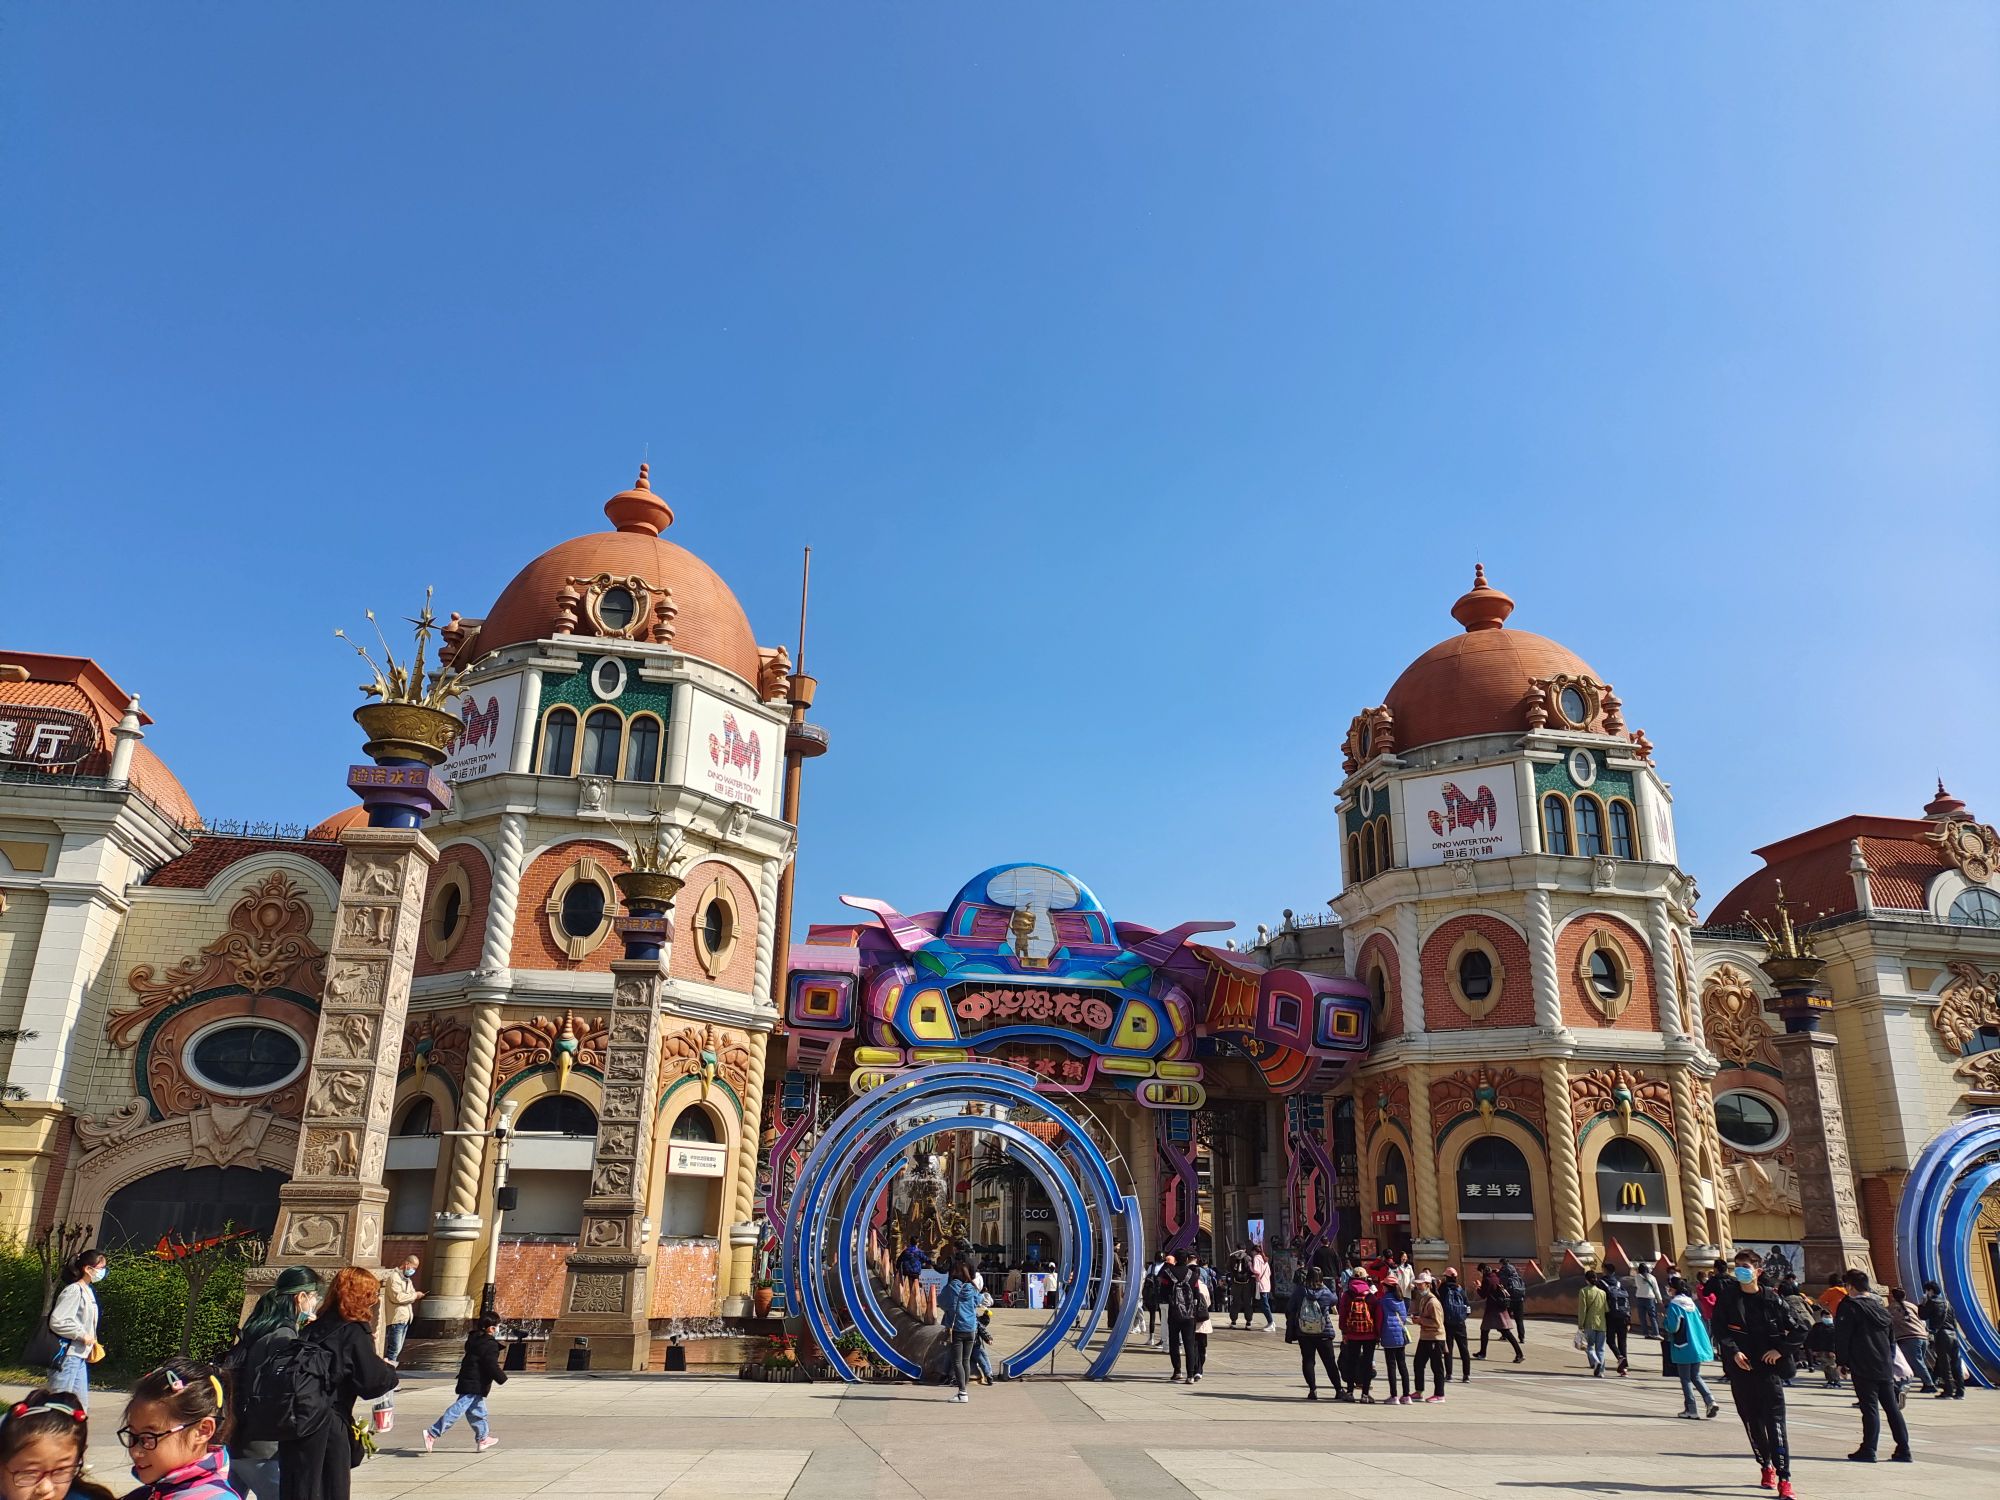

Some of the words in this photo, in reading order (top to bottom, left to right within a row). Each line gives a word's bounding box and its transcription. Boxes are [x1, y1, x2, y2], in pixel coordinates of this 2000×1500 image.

[443, 762, 458, 771] DINO
[458, 757, 477, 766] WATER
[478, 752, 497, 763] TOWN
[707, 769, 723, 781] DINO
[723, 775, 743, 789] WATER
[743, 783, 761, 796] TOWN
[1432, 841, 1452, 850] DINO
[1452, 838, 1478, 847] WATER
[1479, 835, 1503, 845] TOWN
[1466, 1183, 1521, 1197] 麦当劳
